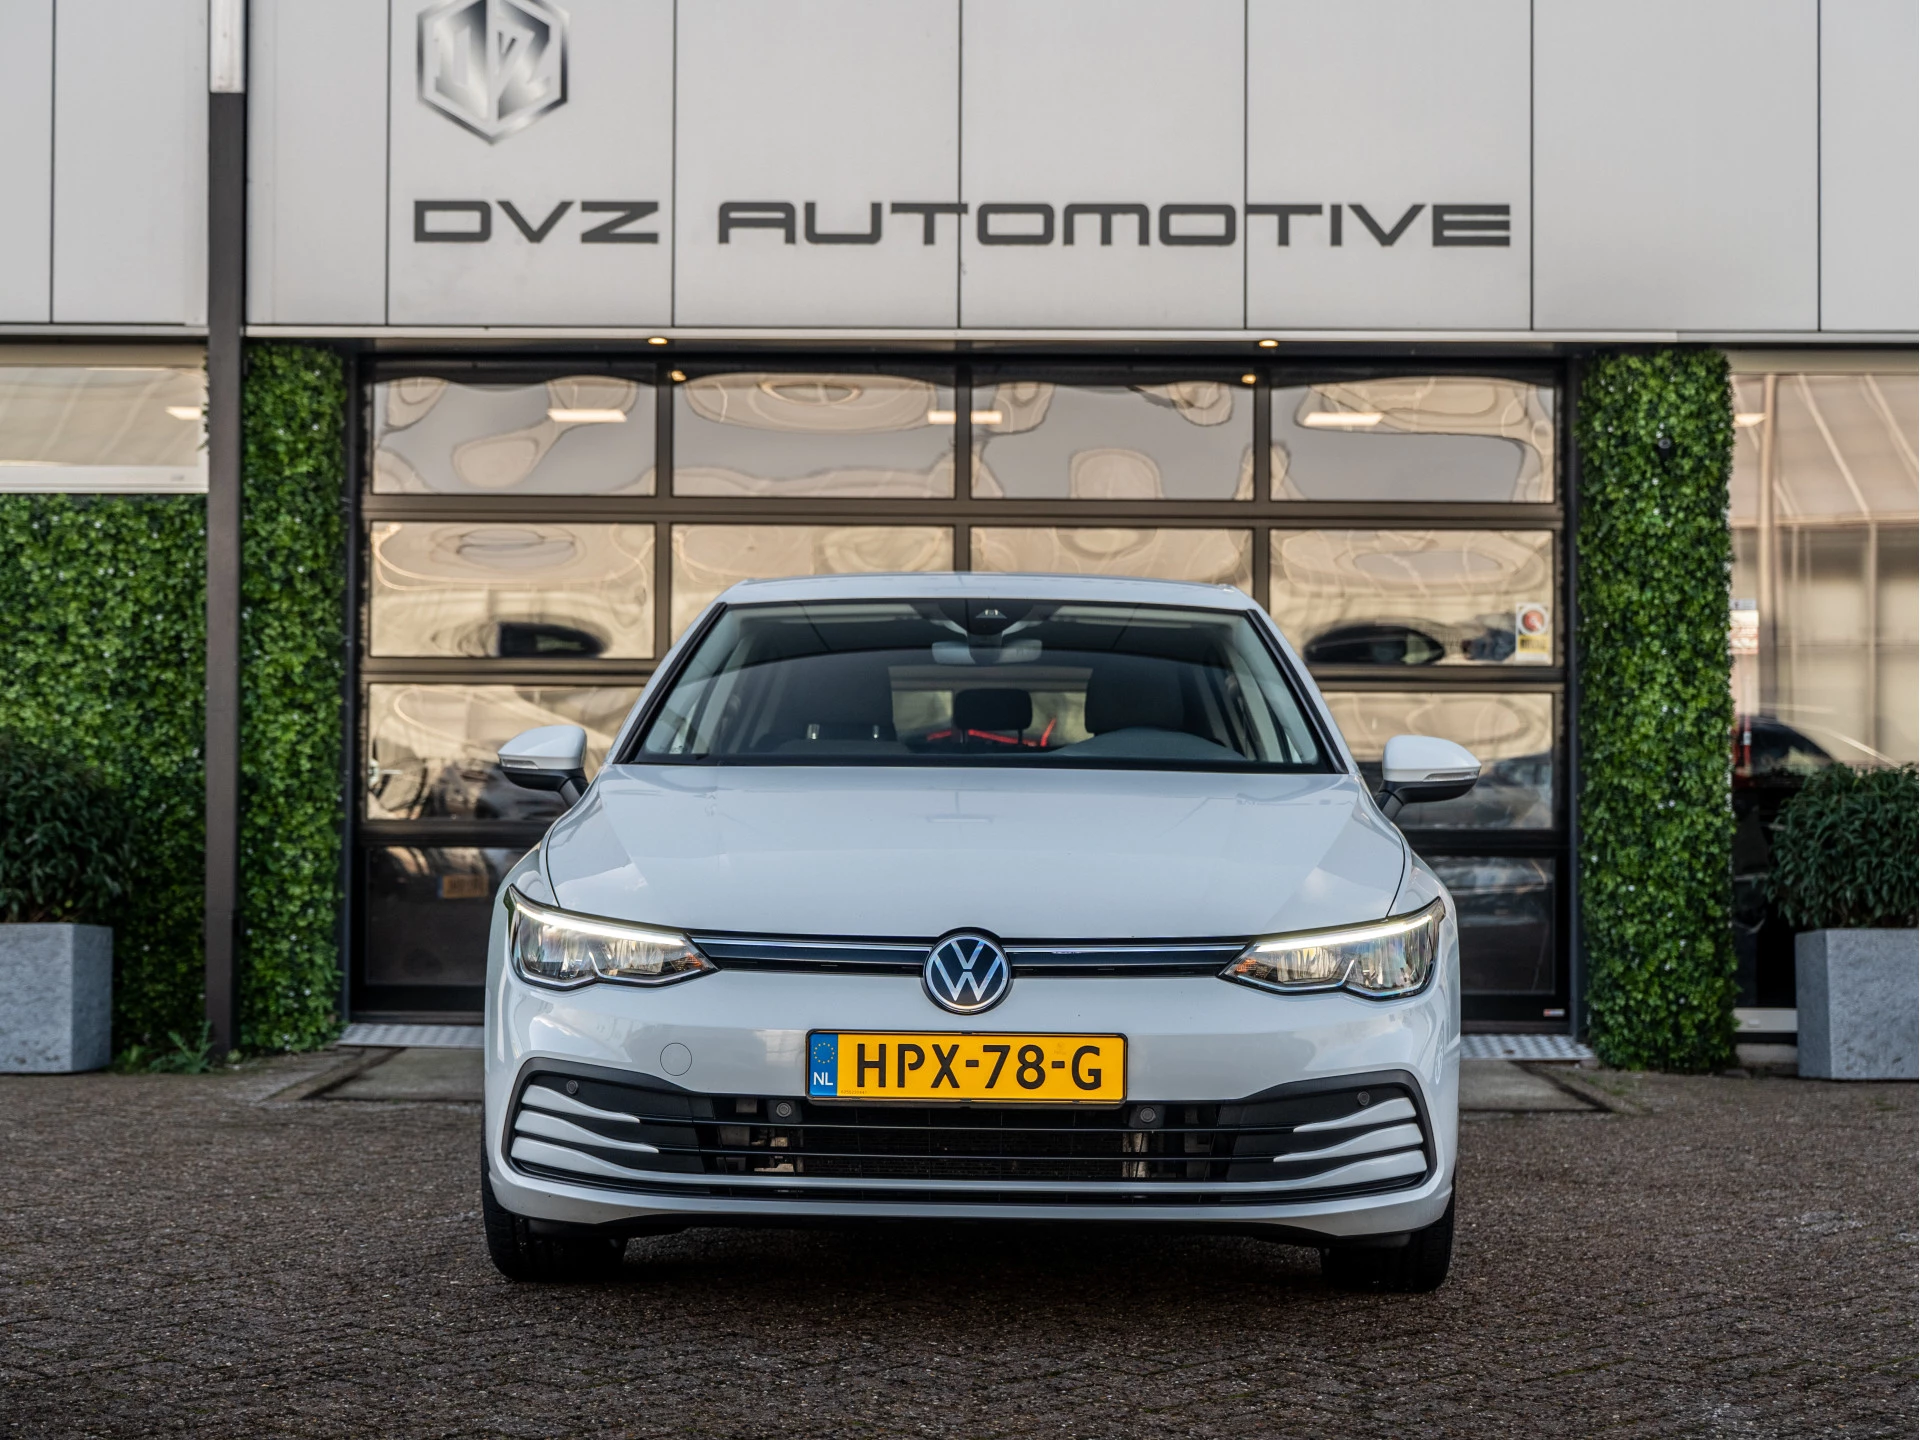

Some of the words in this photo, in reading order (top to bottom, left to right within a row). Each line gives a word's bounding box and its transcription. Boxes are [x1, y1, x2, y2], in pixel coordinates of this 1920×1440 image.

[413, 200, 659, 244] DVZ
[718, 201, 1511, 247] AUTOMOTIVE
[813, 1071, 834, 1086] NL
[856, 1043, 1102, 1091] HPX-78-G
